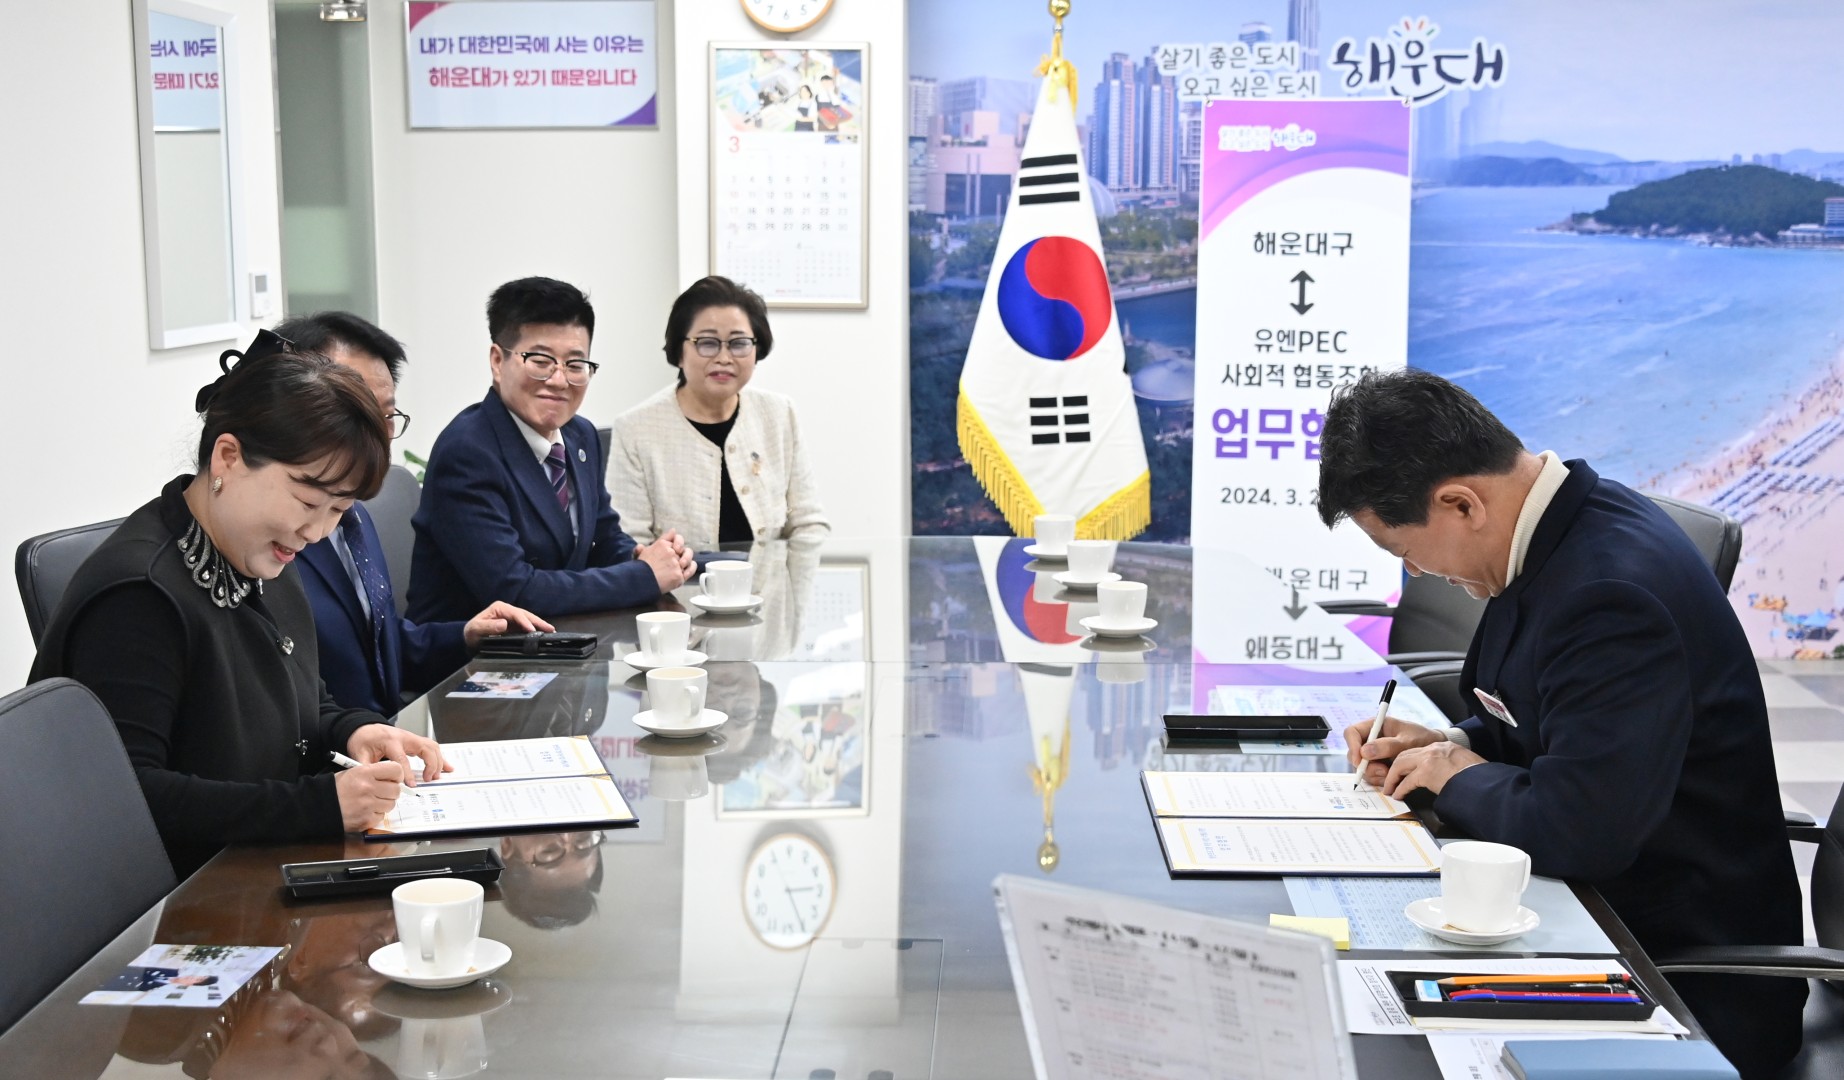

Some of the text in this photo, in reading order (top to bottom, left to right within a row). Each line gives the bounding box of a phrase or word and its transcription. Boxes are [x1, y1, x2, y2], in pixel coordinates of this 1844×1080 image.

[420, 35, 644, 54] 내가 대한민국에 사는 이유는
[1160, 46, 1296, 71] 살기 좋은 도시
[429, 67, 637, 87] 해운대가 있기 때문입니다
[1183, 76, 1317, 97] 오고 싶은 도시
[728, 135, 741, 153] 3
[1253, 231, 1354, 257] 해운대구
[1254, 328, 1348, 353] 유엔PEC
[1221, 363, 1285, 388] 사회적
[1221, 487, 1277, 506] 2024.
[1286, 489, 1302, 506] 3.
